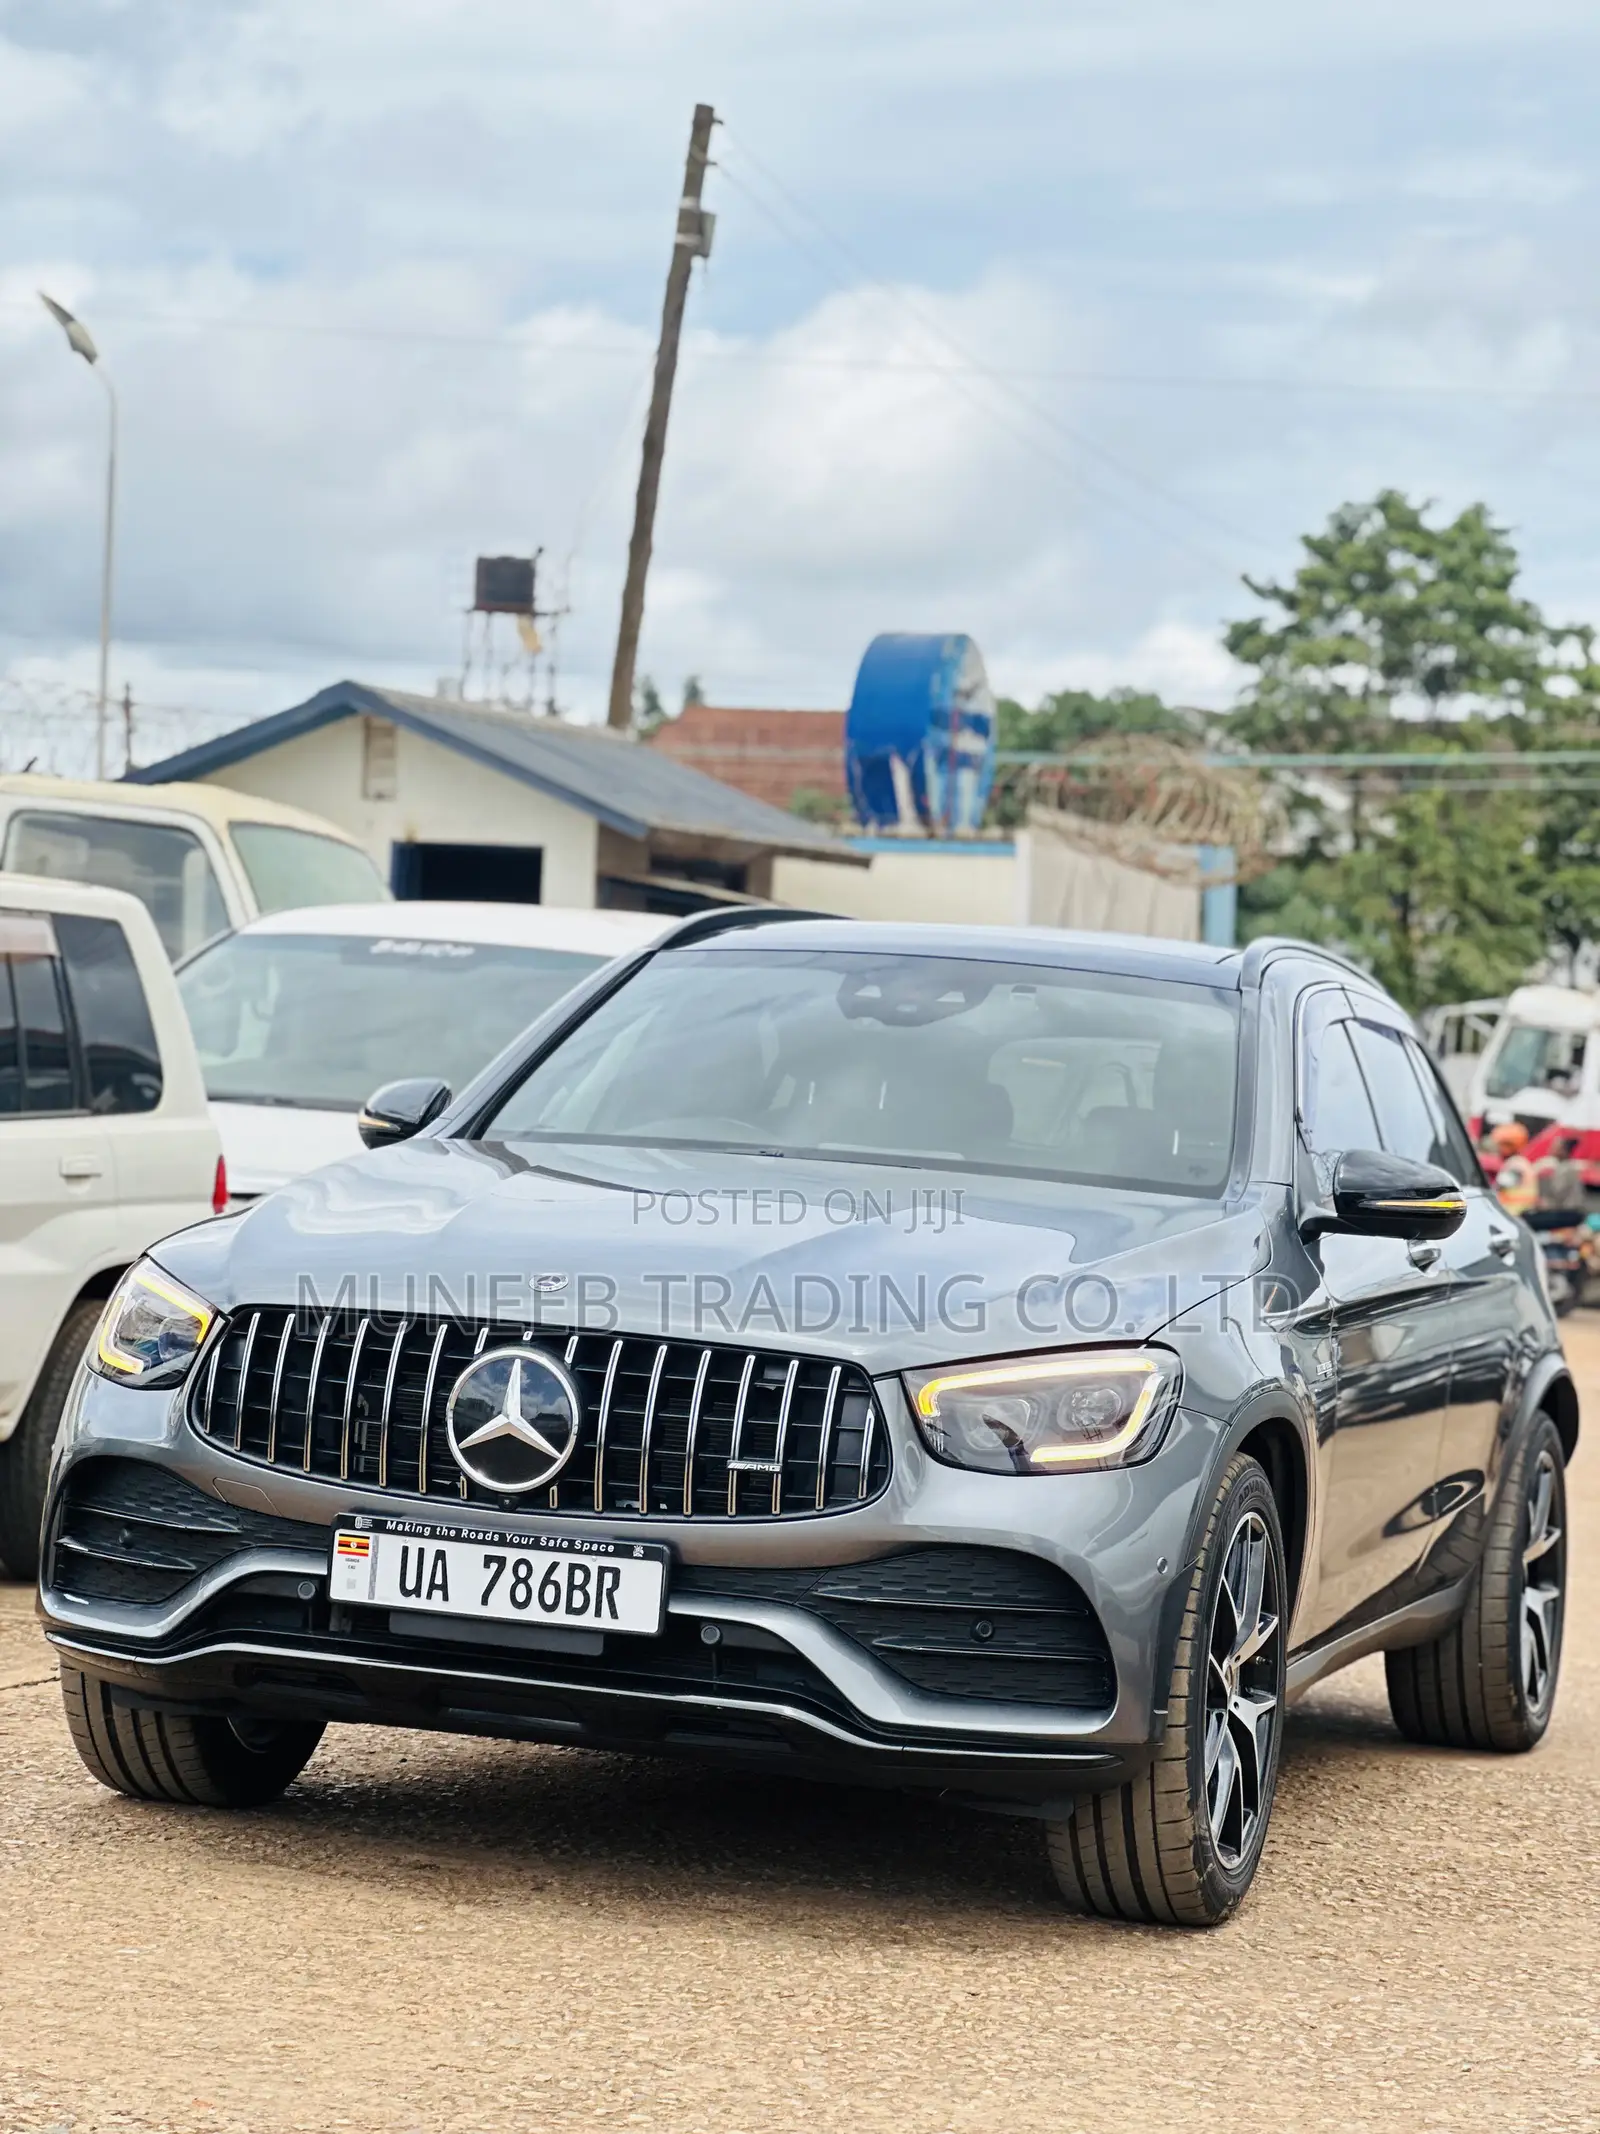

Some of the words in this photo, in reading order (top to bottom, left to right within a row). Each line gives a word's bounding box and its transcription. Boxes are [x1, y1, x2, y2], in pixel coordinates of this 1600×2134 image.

[744, 1463, 781, 1472] AMG
[386, 1520, 431, 1537] Making
[436, 1526, 457, 1538] the
[461, 1528, 500, 1542] Roads
[505, 1533, 535, 1545] Your
[539, 1536, 569, 1549] Safe
[574, 1540, 615, 1553] Space
[399, 1544, 450, 1602] UA
[480, 1553, 622, 1620] 786BR
